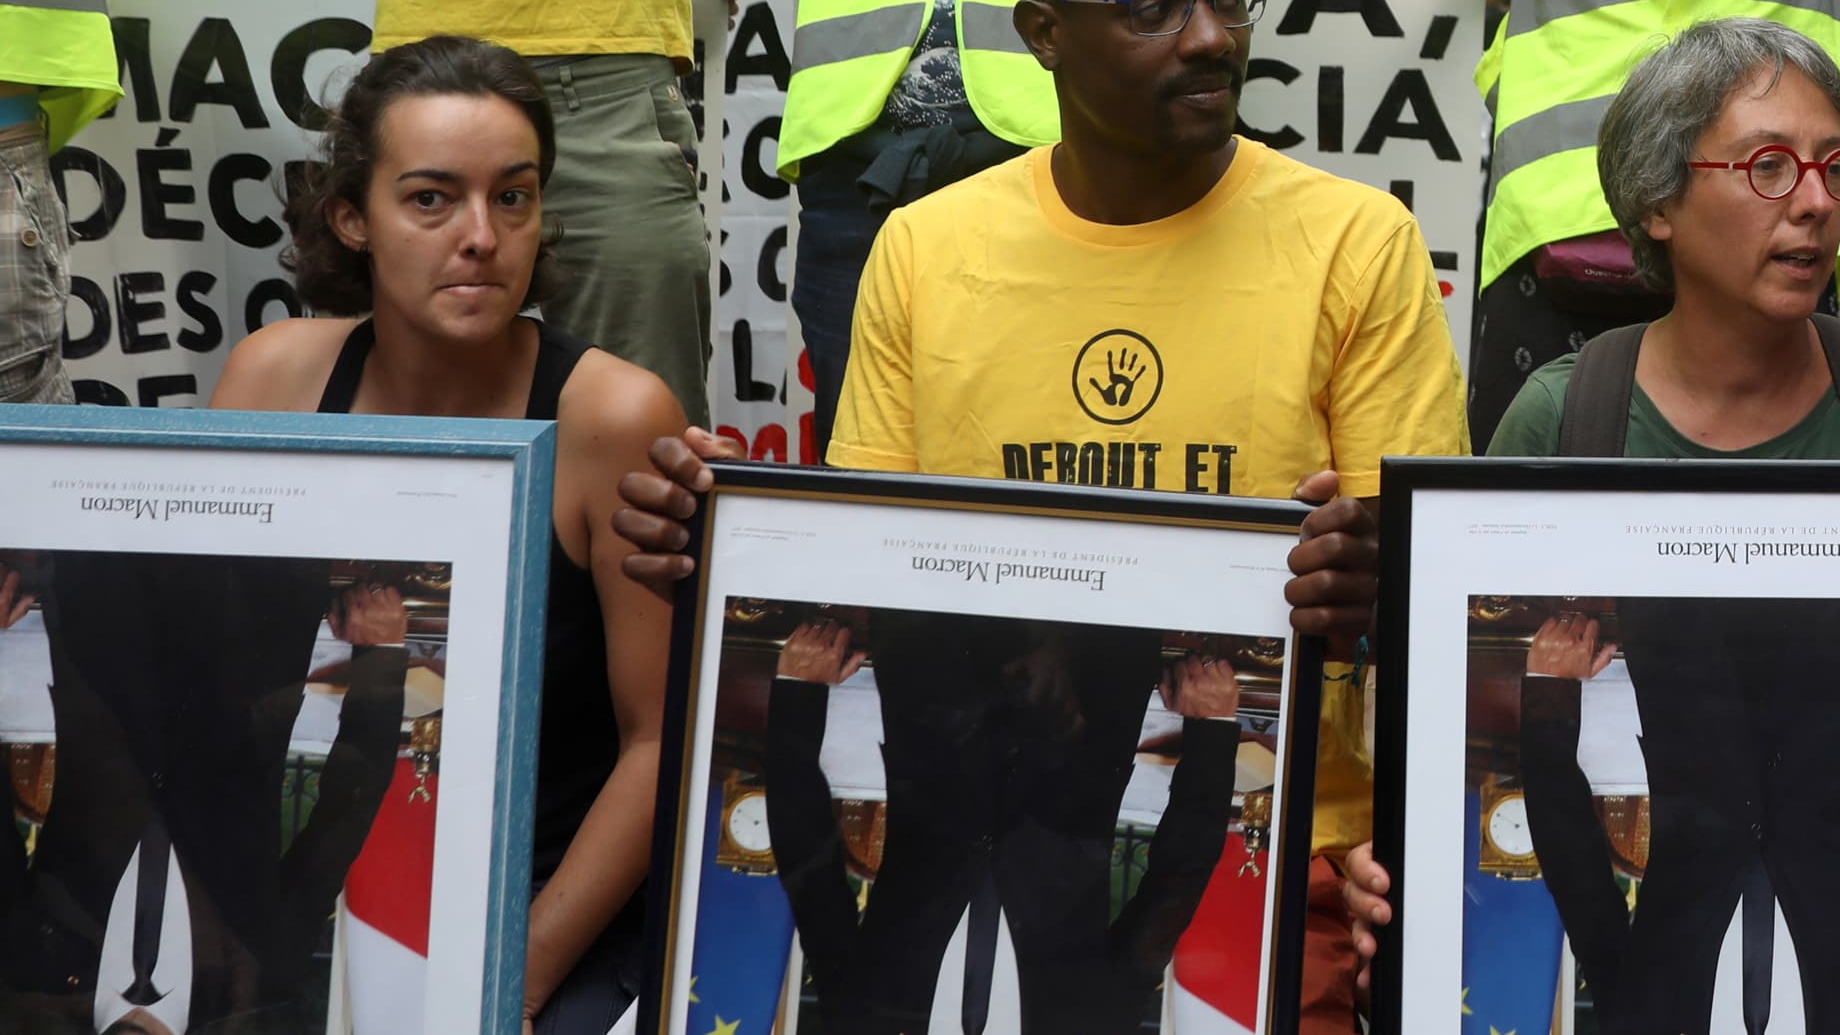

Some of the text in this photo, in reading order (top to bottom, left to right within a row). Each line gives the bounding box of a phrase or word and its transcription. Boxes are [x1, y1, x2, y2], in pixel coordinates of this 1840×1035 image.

[1185, 443, 1237, 495] ET
[81, 497, 274, 524] Emmanuel Macron
[1625, 524, 1692, 535] FRANÇAISE
[1699, 525, 1776, 536] RÉPUBLIQUE
[1782, 526, 1796, 535] LA
[1802, 526, 1817, 535] DE
[1657, 541, 1738, 564] Macron
[911, 556, 1106, 591] Emmanuel Macron
